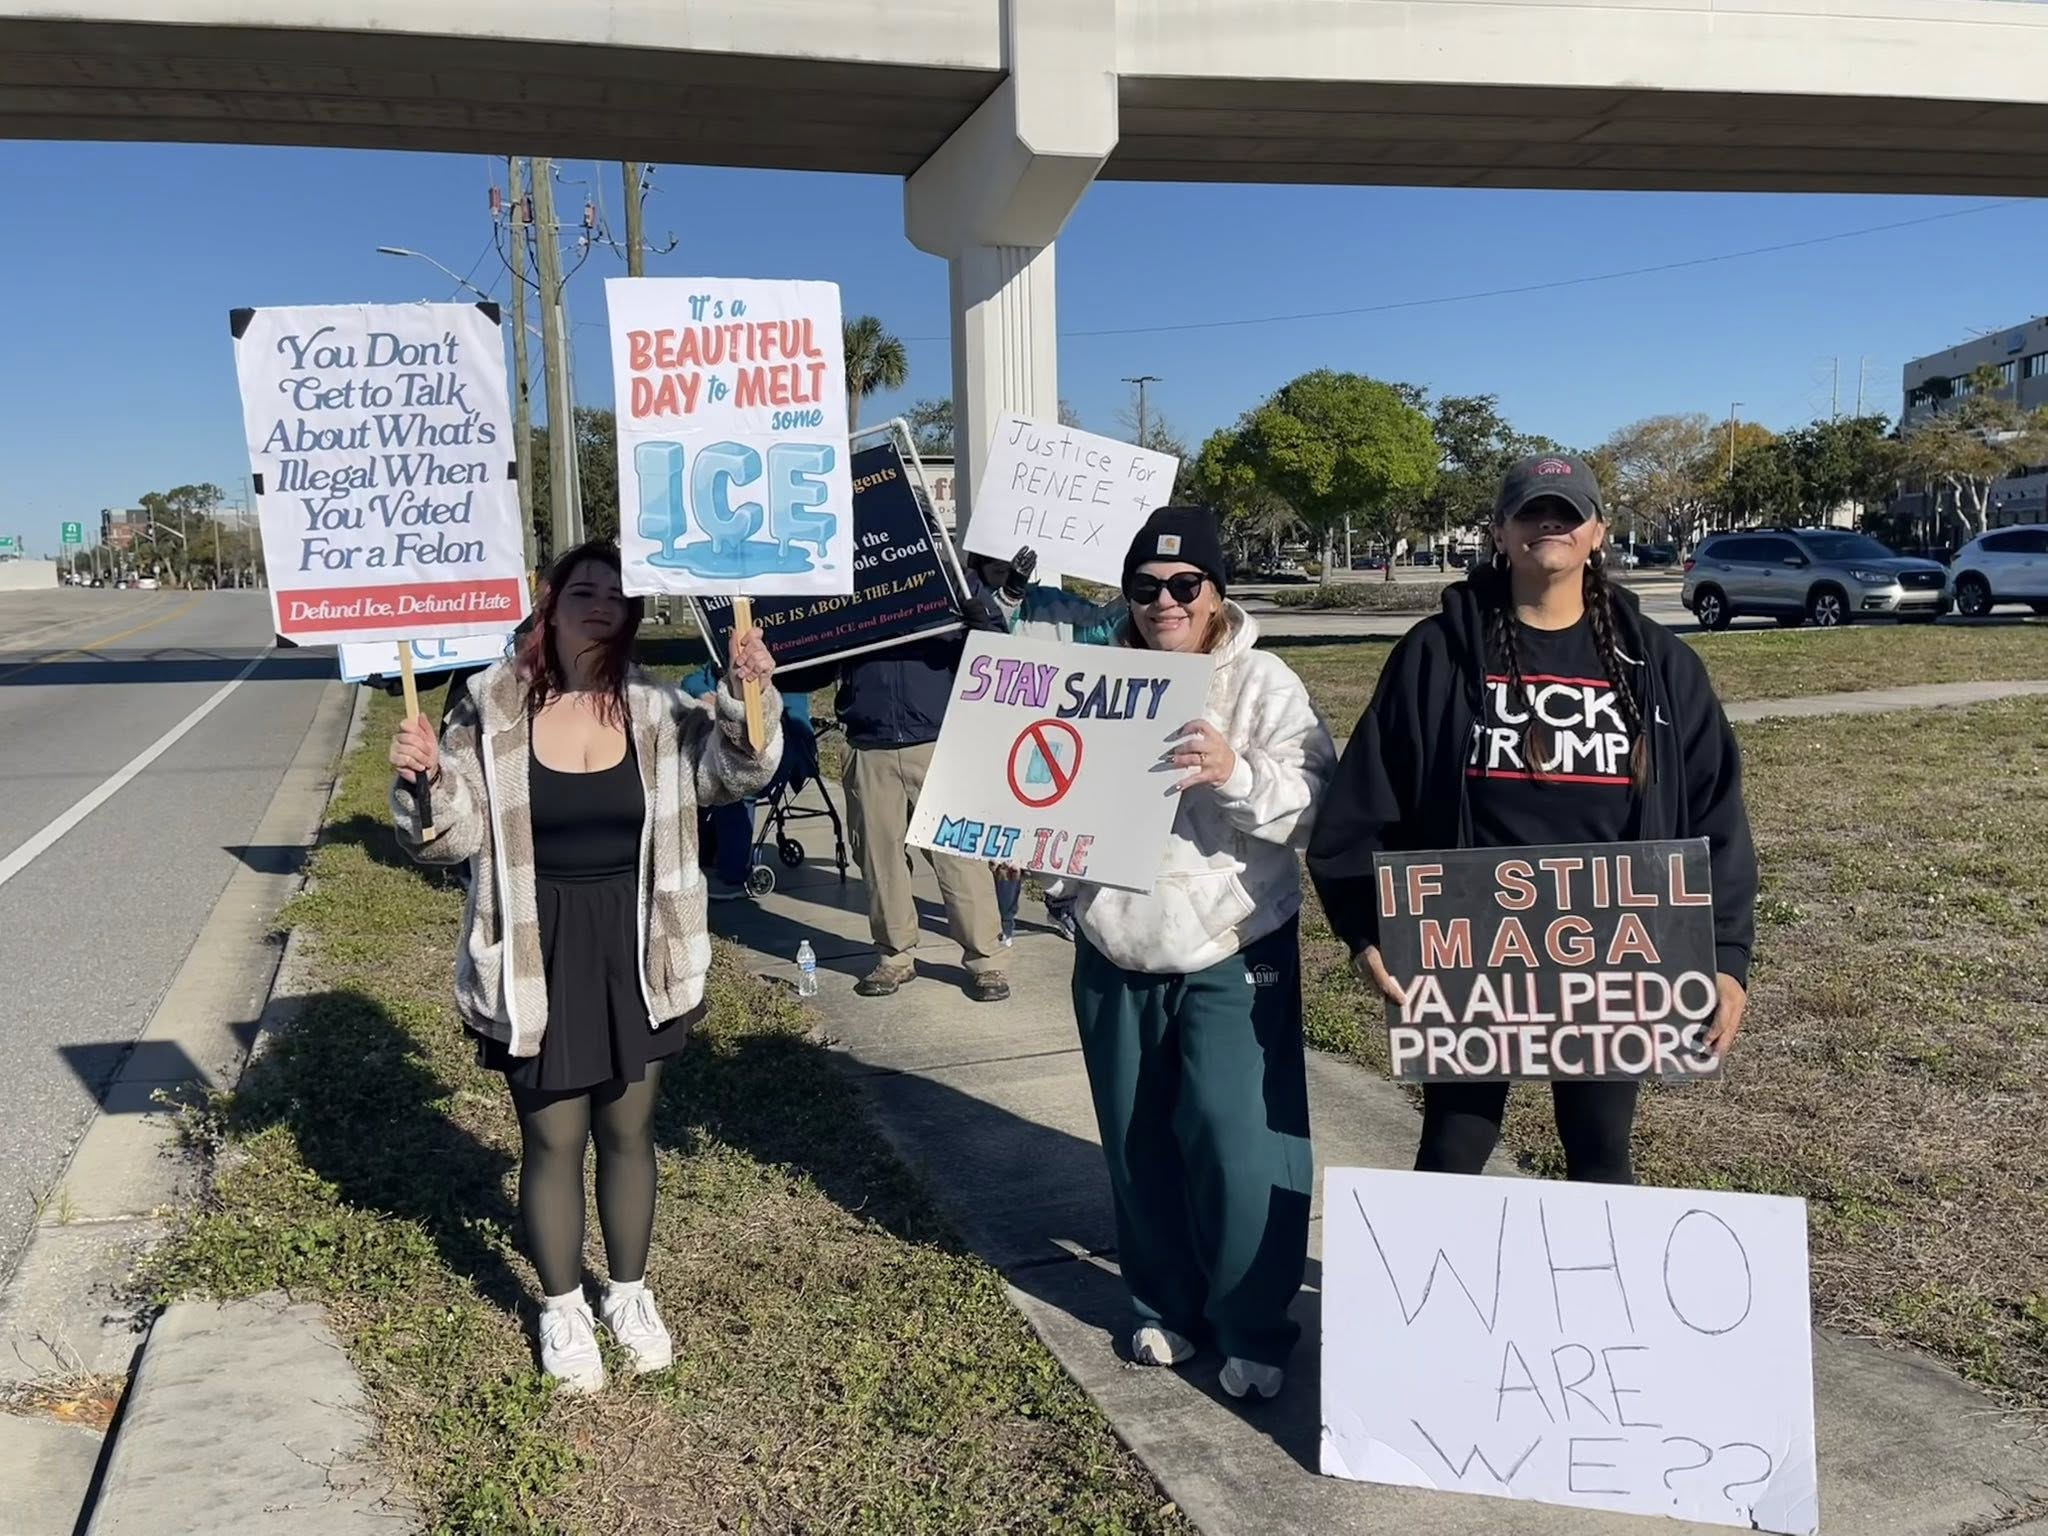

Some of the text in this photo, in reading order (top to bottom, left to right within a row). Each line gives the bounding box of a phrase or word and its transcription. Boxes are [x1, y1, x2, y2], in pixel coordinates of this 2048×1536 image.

[689, 294, 746, 320] It's a
[277, 327, 460, 369] You Don't
[626, 318, 823, 372] BEAUTIFUL
[278, 372, 476, 413] Get to Talk
[630, 363, 826, 418] DAY to MELT
[262, 413, 496, 453] About What's
[771, 408, 824, 431] some
[1009, 420, 1112, 472] Justice
[276, 453, 489, 498] Illegal When
[853, 468, 897, 494] gents
[1011, 461, 1113, 505] RENEE
[300, 490, 474, 531] You Voted
[634, 441, 837, 556] ICE
[862, 531, 891, 548] the
[1014, 506, 1104, 546] ALEX
[298, 533, 486, 571] For a Felon
[853, 555, 879, 571] ole
[881, 538, 929, 562] Good
[289, 590, 511, 621] Defund Ice, Defund Hate
[771, 634, 819, 652] Restraints
[835, 623, 856, 636] ICE
[858, 615, 877, 631] and
[879, 606, 914, 624] Border
[917, 596, 949, 613] Patrol
[789, 607, 804, 622] IS
[808, 591, 863, 617] ABOVE
[863, 582, 891, 601] THE
[960, 655, 1171, 720] STAY SALTY
[1486, 682, 1627, 732] UCK
[933, 814, 1095, 876] MELT ICE
[1378, 853, 1711, 917] IF STILL
[1420, 913, 1661, 970] MAGA
[1389, 970, 1717, 1024] YA ALL PEDO
[1389, 1023, 1721, 1076] PROTECTORS
[1352, 1187, 1752, 1336] WHO
[1495, 1340, 1663, 1429] ARE
